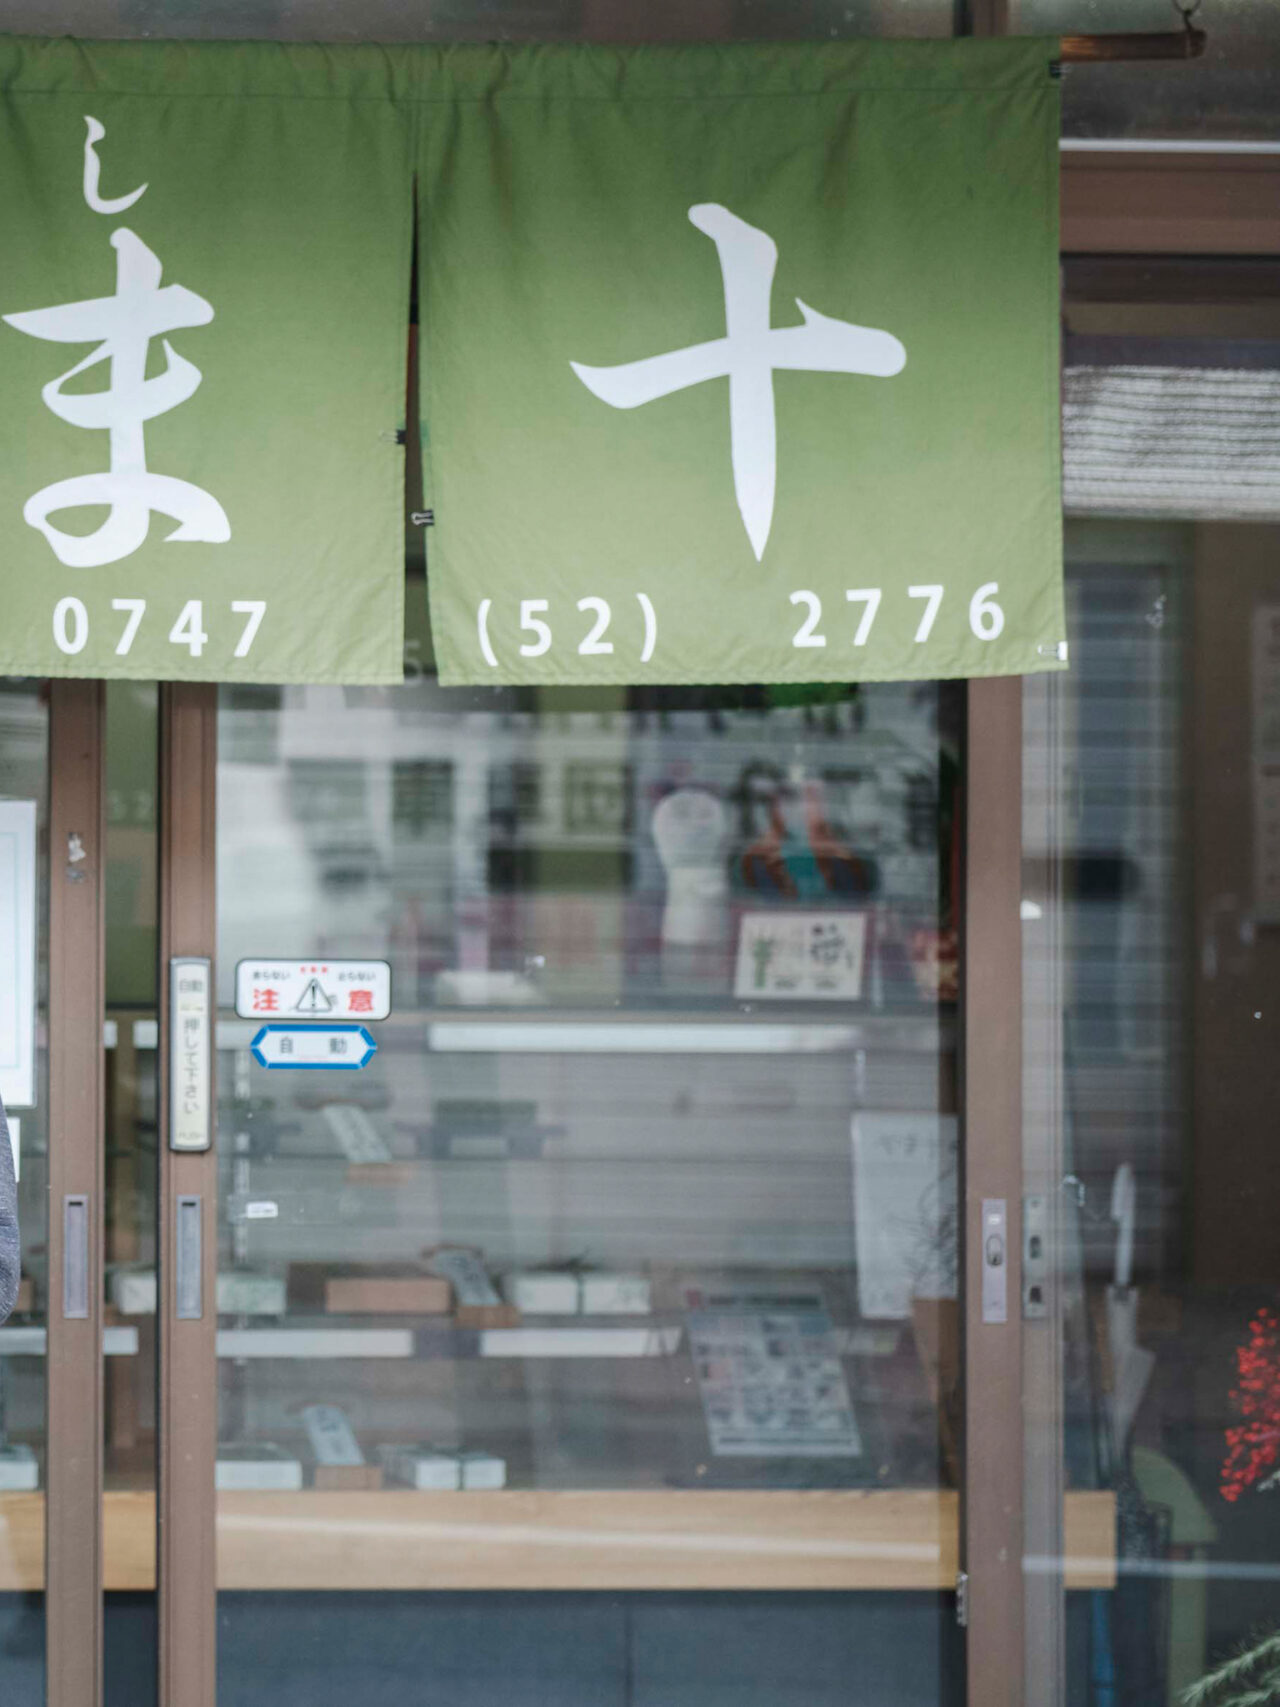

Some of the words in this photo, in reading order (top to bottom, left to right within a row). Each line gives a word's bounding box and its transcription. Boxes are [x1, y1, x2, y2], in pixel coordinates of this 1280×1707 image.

[52, 596, 268, 660] 0747
[476, 592, 658, 667] (52)
[788, 581, 1006, 648] 2776
[279, 1036, 348, 1054] 自動
